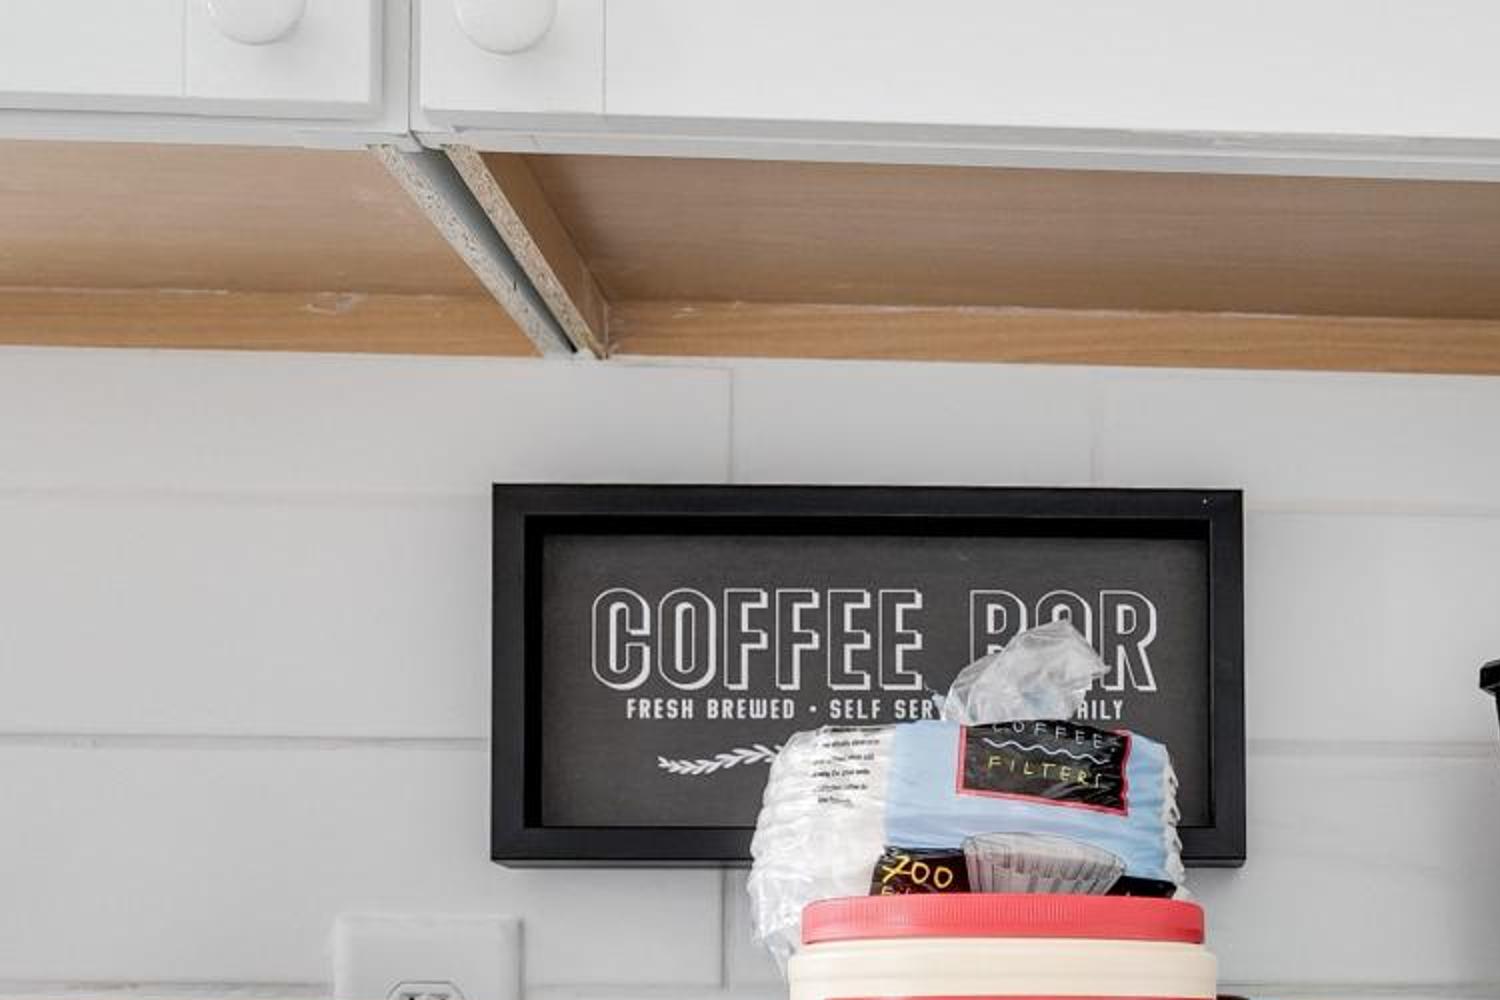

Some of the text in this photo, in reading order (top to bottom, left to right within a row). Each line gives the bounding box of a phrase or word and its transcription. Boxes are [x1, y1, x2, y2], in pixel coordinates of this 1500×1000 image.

[592, 587, 923, 691] COFFEE
[626, 699, 694, 719] FRESH
[707, 699, 795, 719] BREWED
[829, 699, 881, 719] SELF
[1076, 699, 1125, 720] AILY
